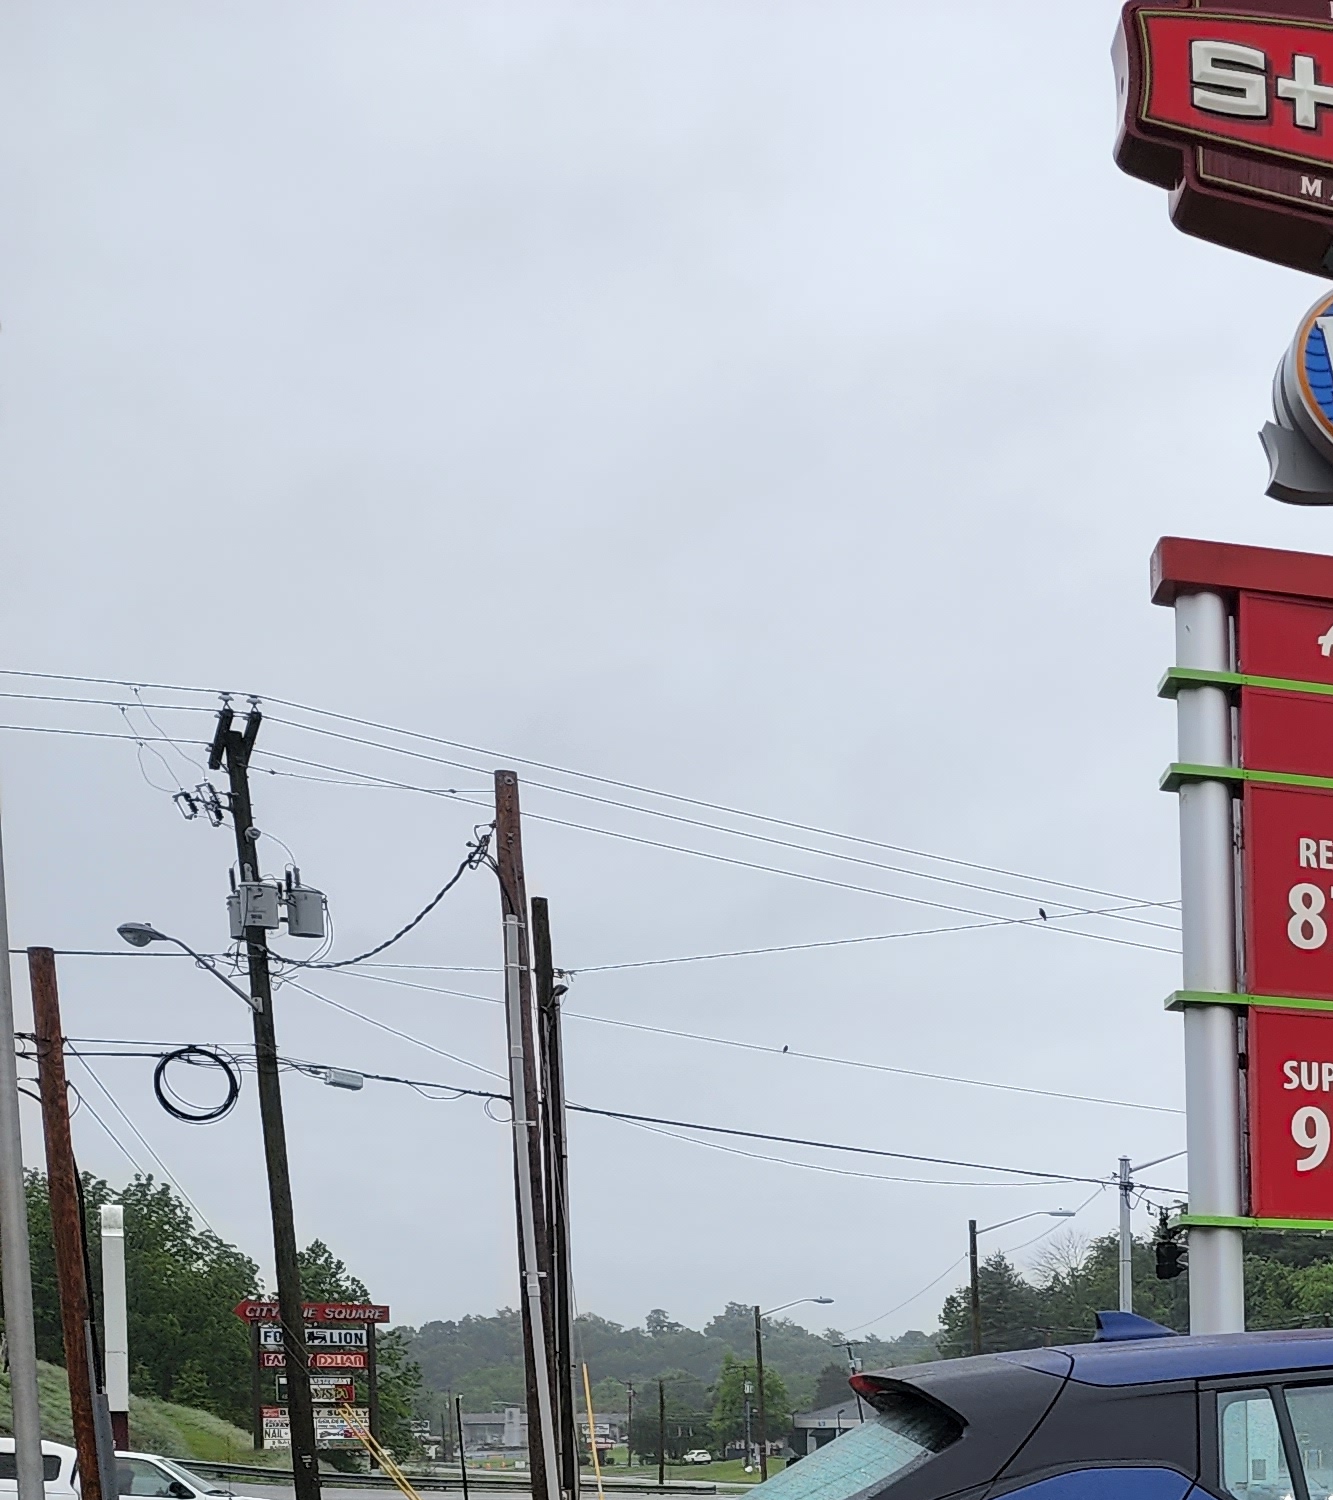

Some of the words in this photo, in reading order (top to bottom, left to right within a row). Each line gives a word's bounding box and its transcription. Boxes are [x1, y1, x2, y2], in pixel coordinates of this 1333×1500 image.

[245, 1305, 279, 1317] CITY
[323, 1307, 384, 1320] SQUARE
[263, 1331, 283, 1344] FO
[329, 1331, 364, 1345] LION
[316, 1354, 365, 1367] DOLLAR
